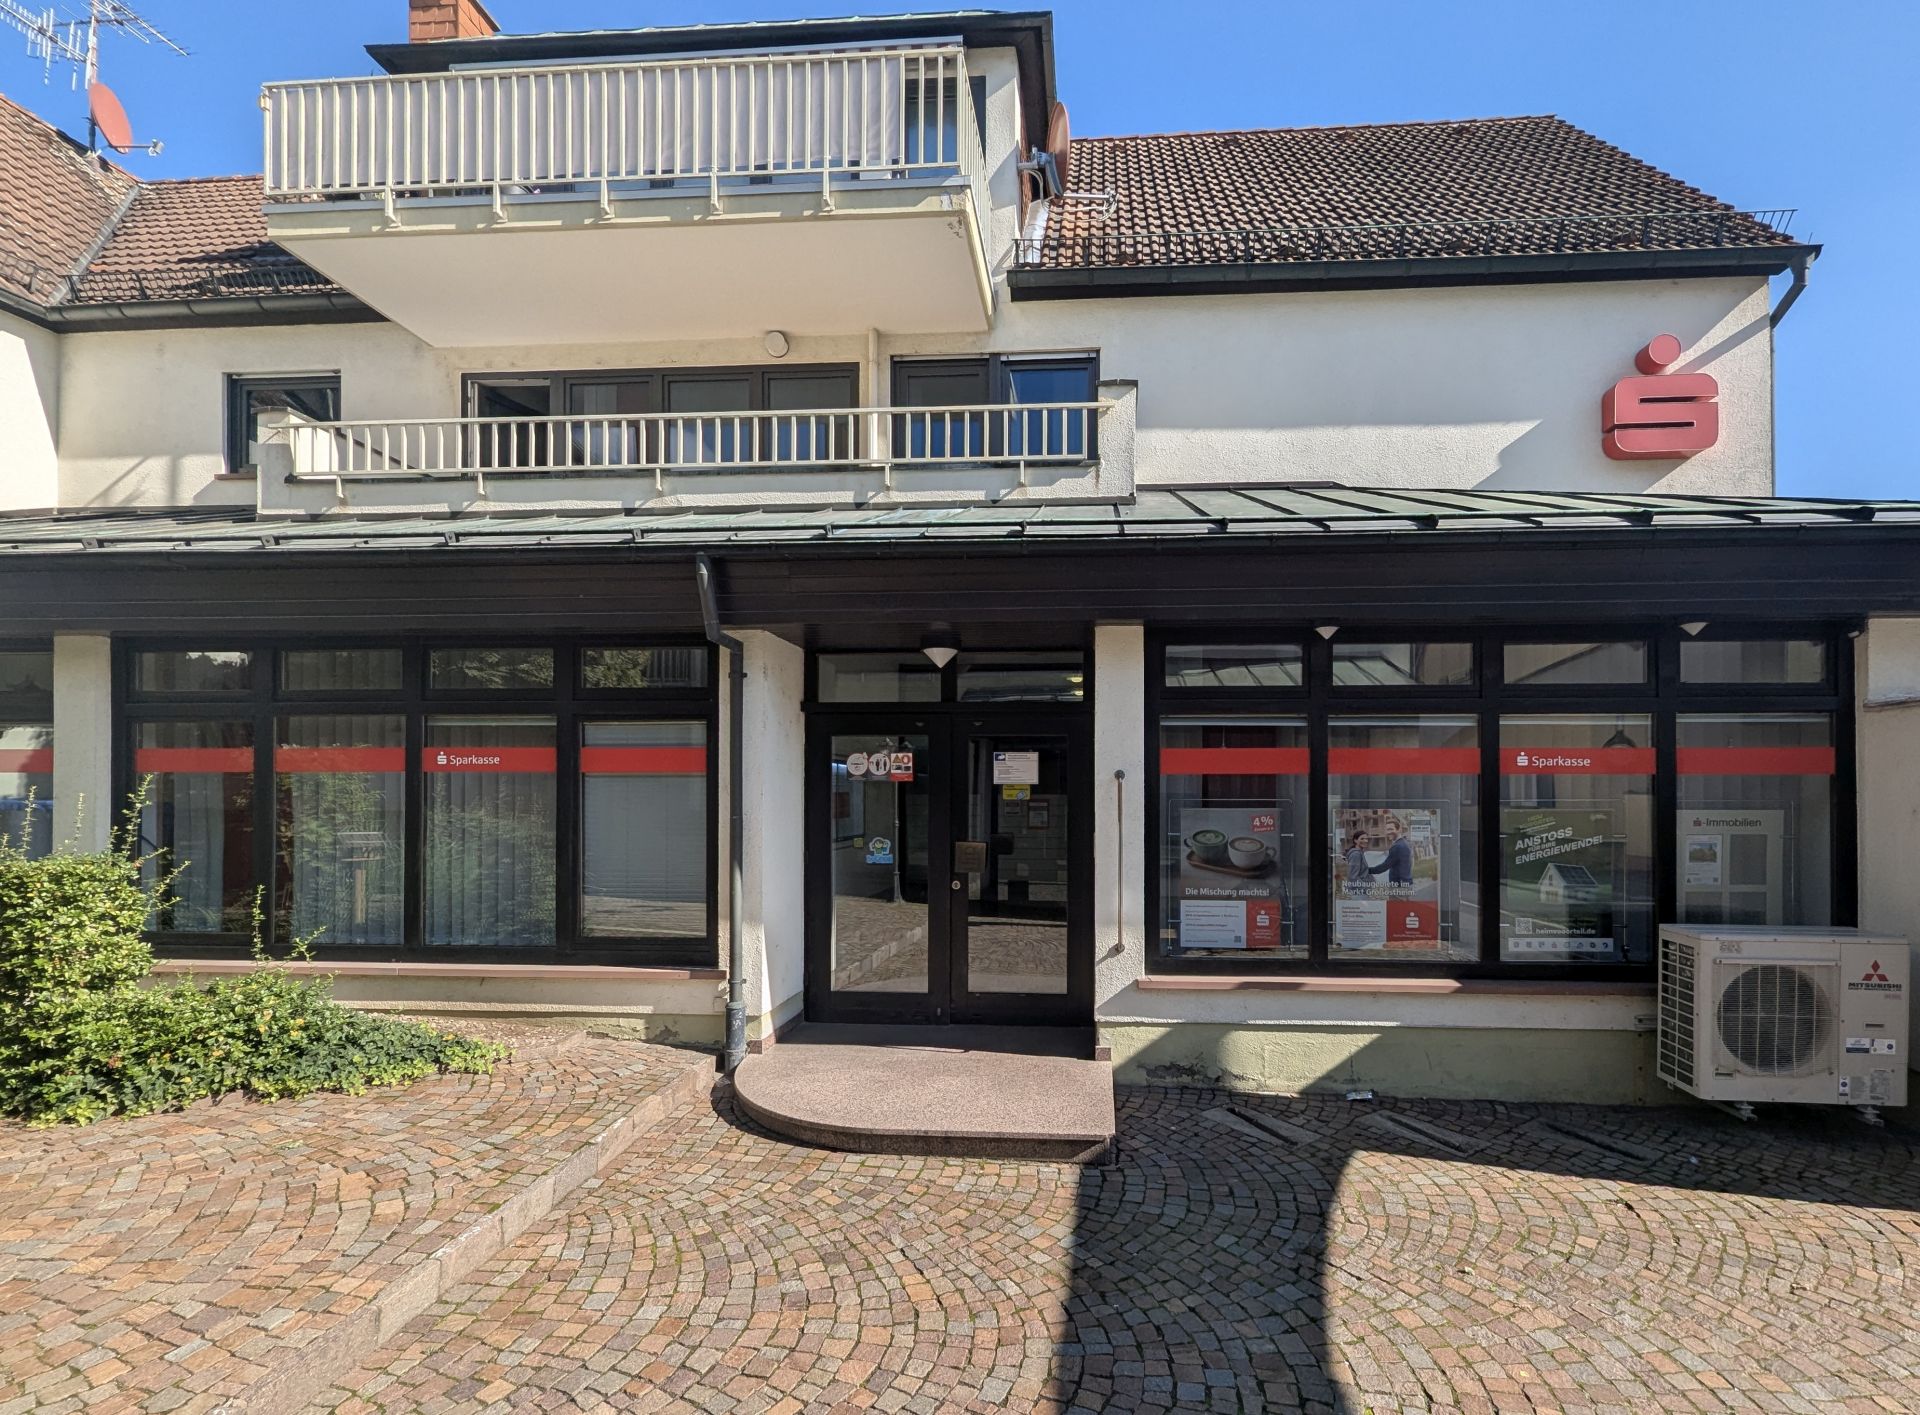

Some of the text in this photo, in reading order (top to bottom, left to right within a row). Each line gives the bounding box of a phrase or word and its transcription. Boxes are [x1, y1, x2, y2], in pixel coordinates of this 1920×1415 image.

[450, 755, 500, 766] Sparkasse
[1532, 755, 1591, 768] Sparkasse
[1515, 827, 1573, 850] ANSTOSS
[1515, 835, 1603, 865] ENERGIEWENDE!
[1400, 880, 1410, 888] im
[1185, 887, 1270, 897] Die Mischung machts!
[1342, 888, 1365, 896] Markt
